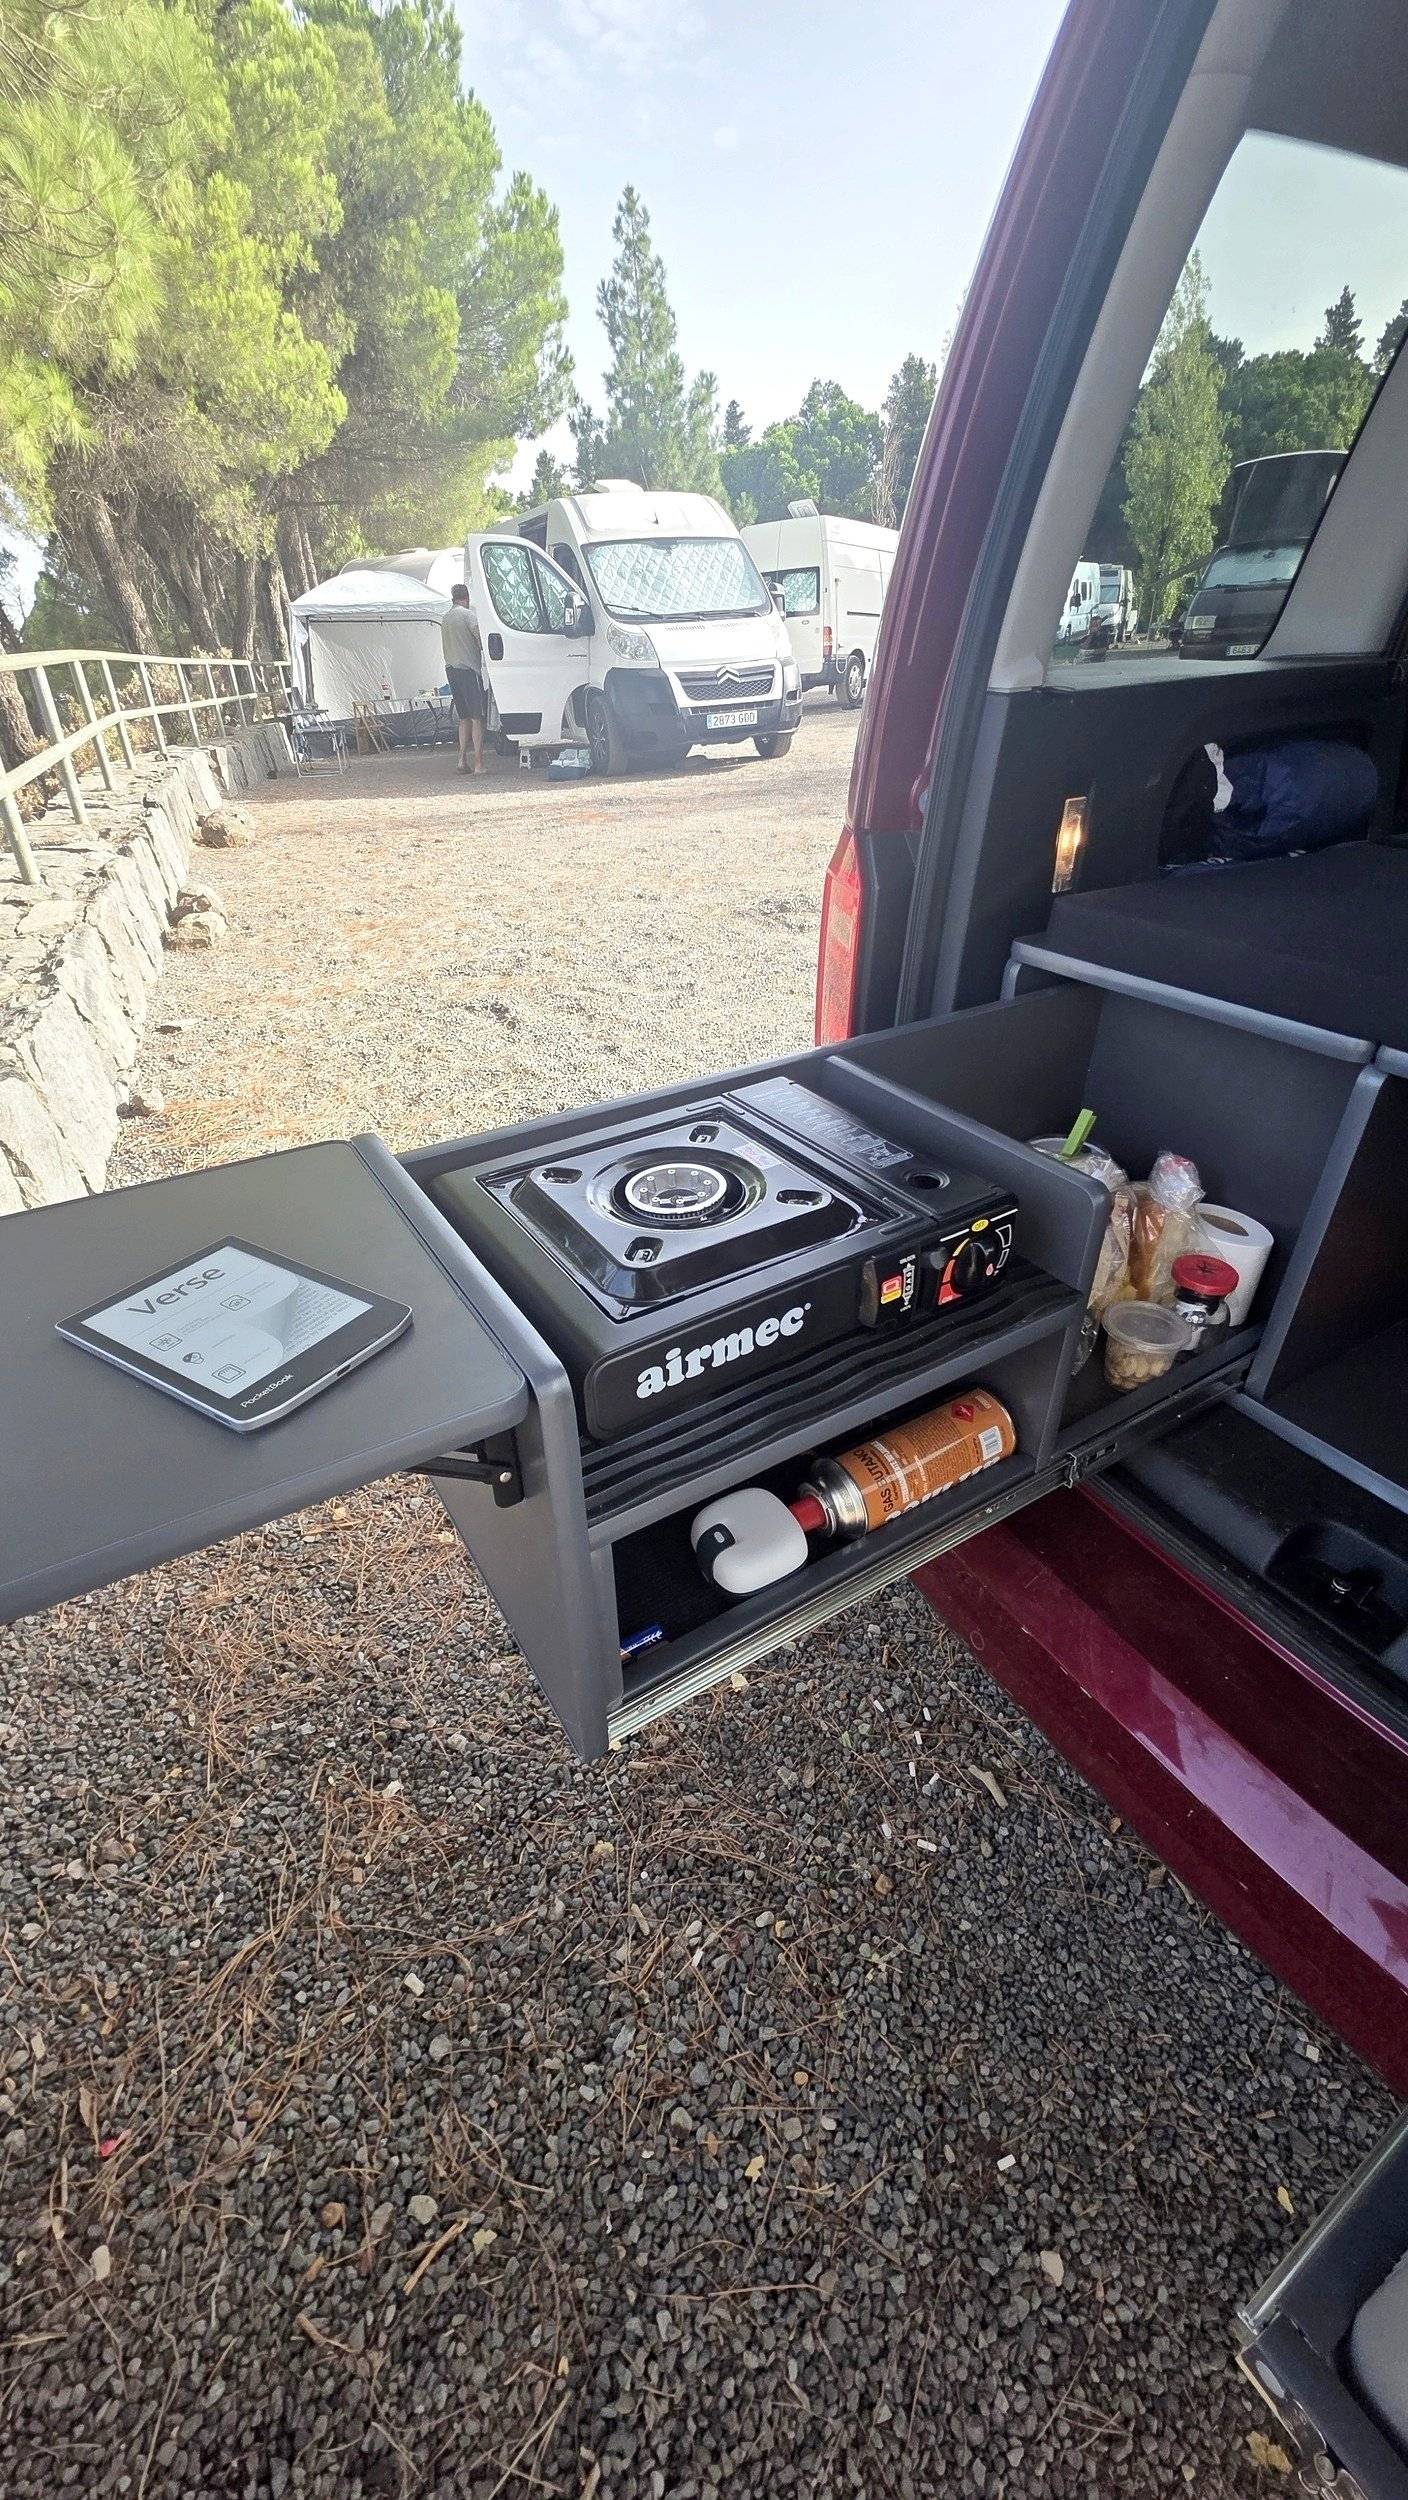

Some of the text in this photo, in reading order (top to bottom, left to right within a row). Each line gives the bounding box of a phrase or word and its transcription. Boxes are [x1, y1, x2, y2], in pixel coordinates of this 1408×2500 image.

[713, 715, 735, 726] 2873
[125, 1268, 226, 1315] Verse
[636, 1304, 807, 1399] airmec
[240, 1372, 295, 1408] PocketBook
[880, 1488, 894, 1513] GAS
